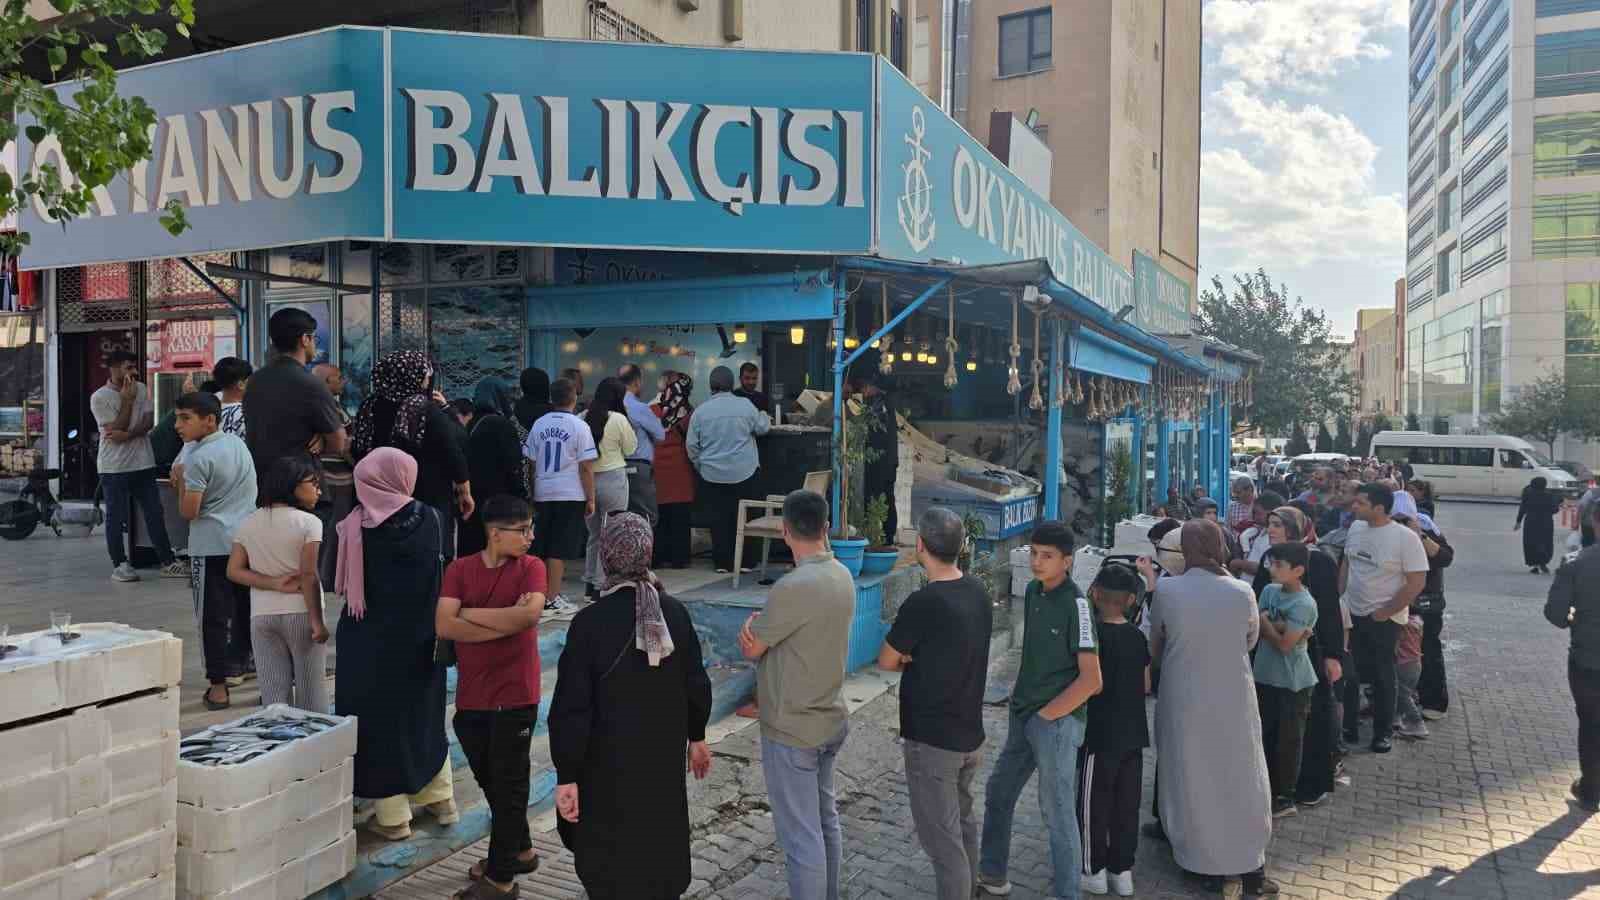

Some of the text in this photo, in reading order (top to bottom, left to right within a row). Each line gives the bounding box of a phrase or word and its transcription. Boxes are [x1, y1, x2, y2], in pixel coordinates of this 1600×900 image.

[398, 88, 865, 216] BALIKÇISI
[953, 144, 1068, 284] OKYANUS
[167, 336, 208, 352] KASAP
[544, 441, 562, 472] 11
